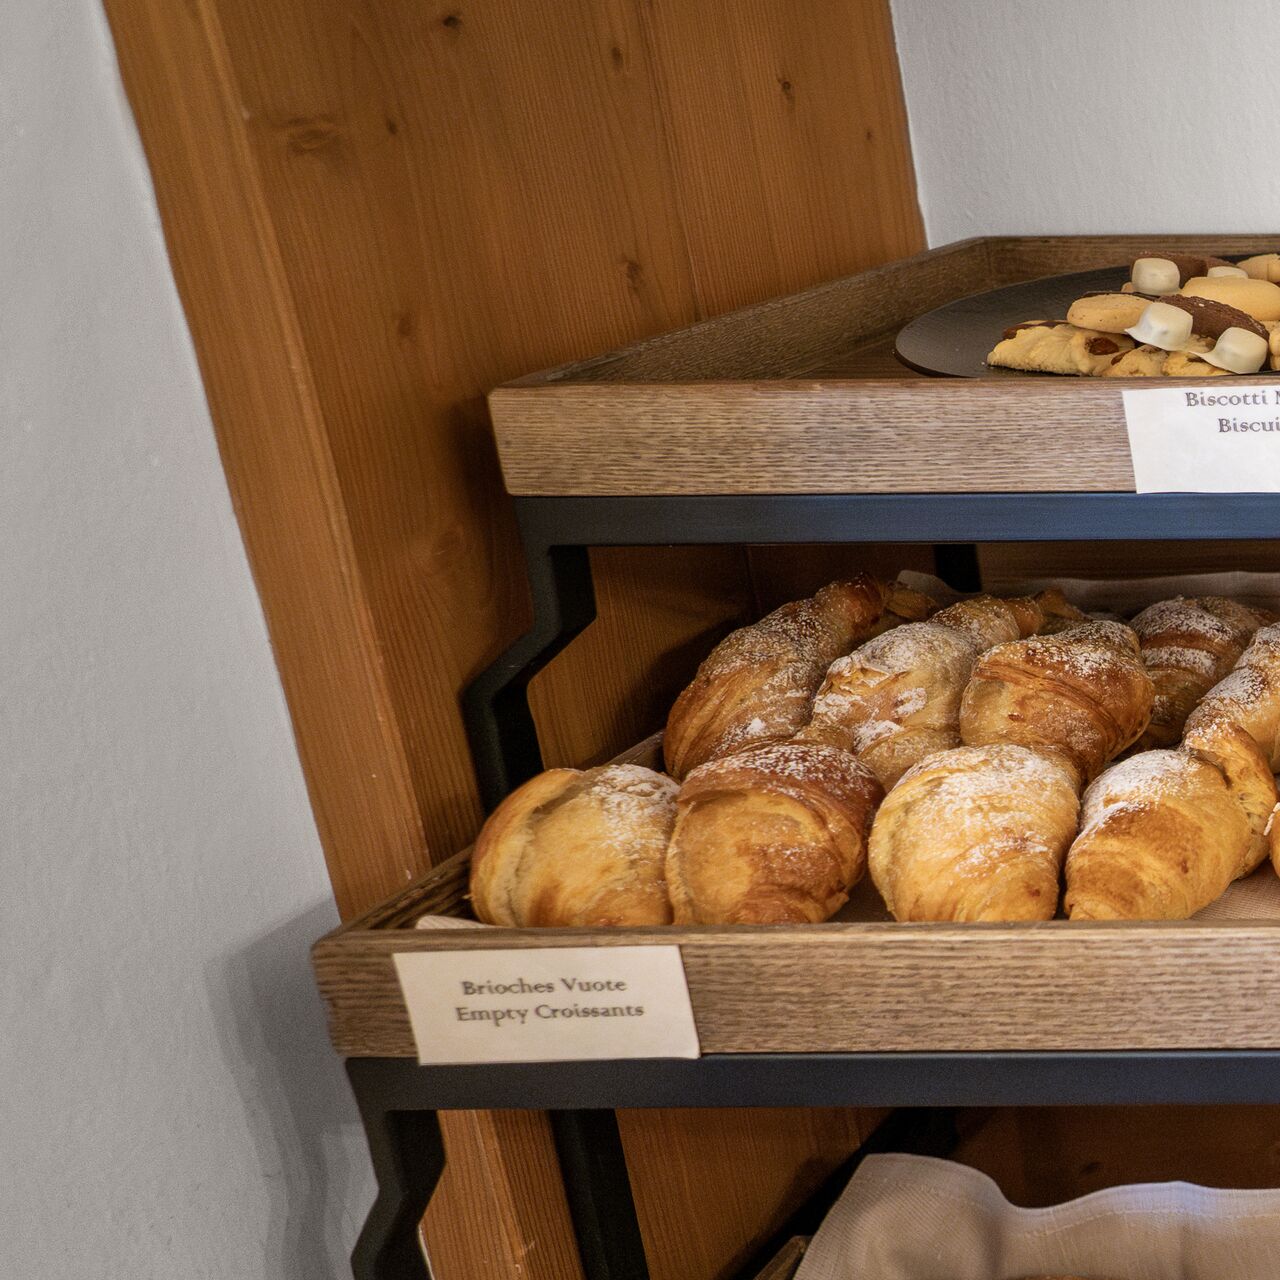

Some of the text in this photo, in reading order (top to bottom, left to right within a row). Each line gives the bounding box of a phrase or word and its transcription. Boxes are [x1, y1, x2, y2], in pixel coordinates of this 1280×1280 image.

[1185, 390, 1268, 407] Biscotti
[461, 977, 628, 995] Brioches Vuote
[455, 1003, 645, 1027] Empty Croissants
